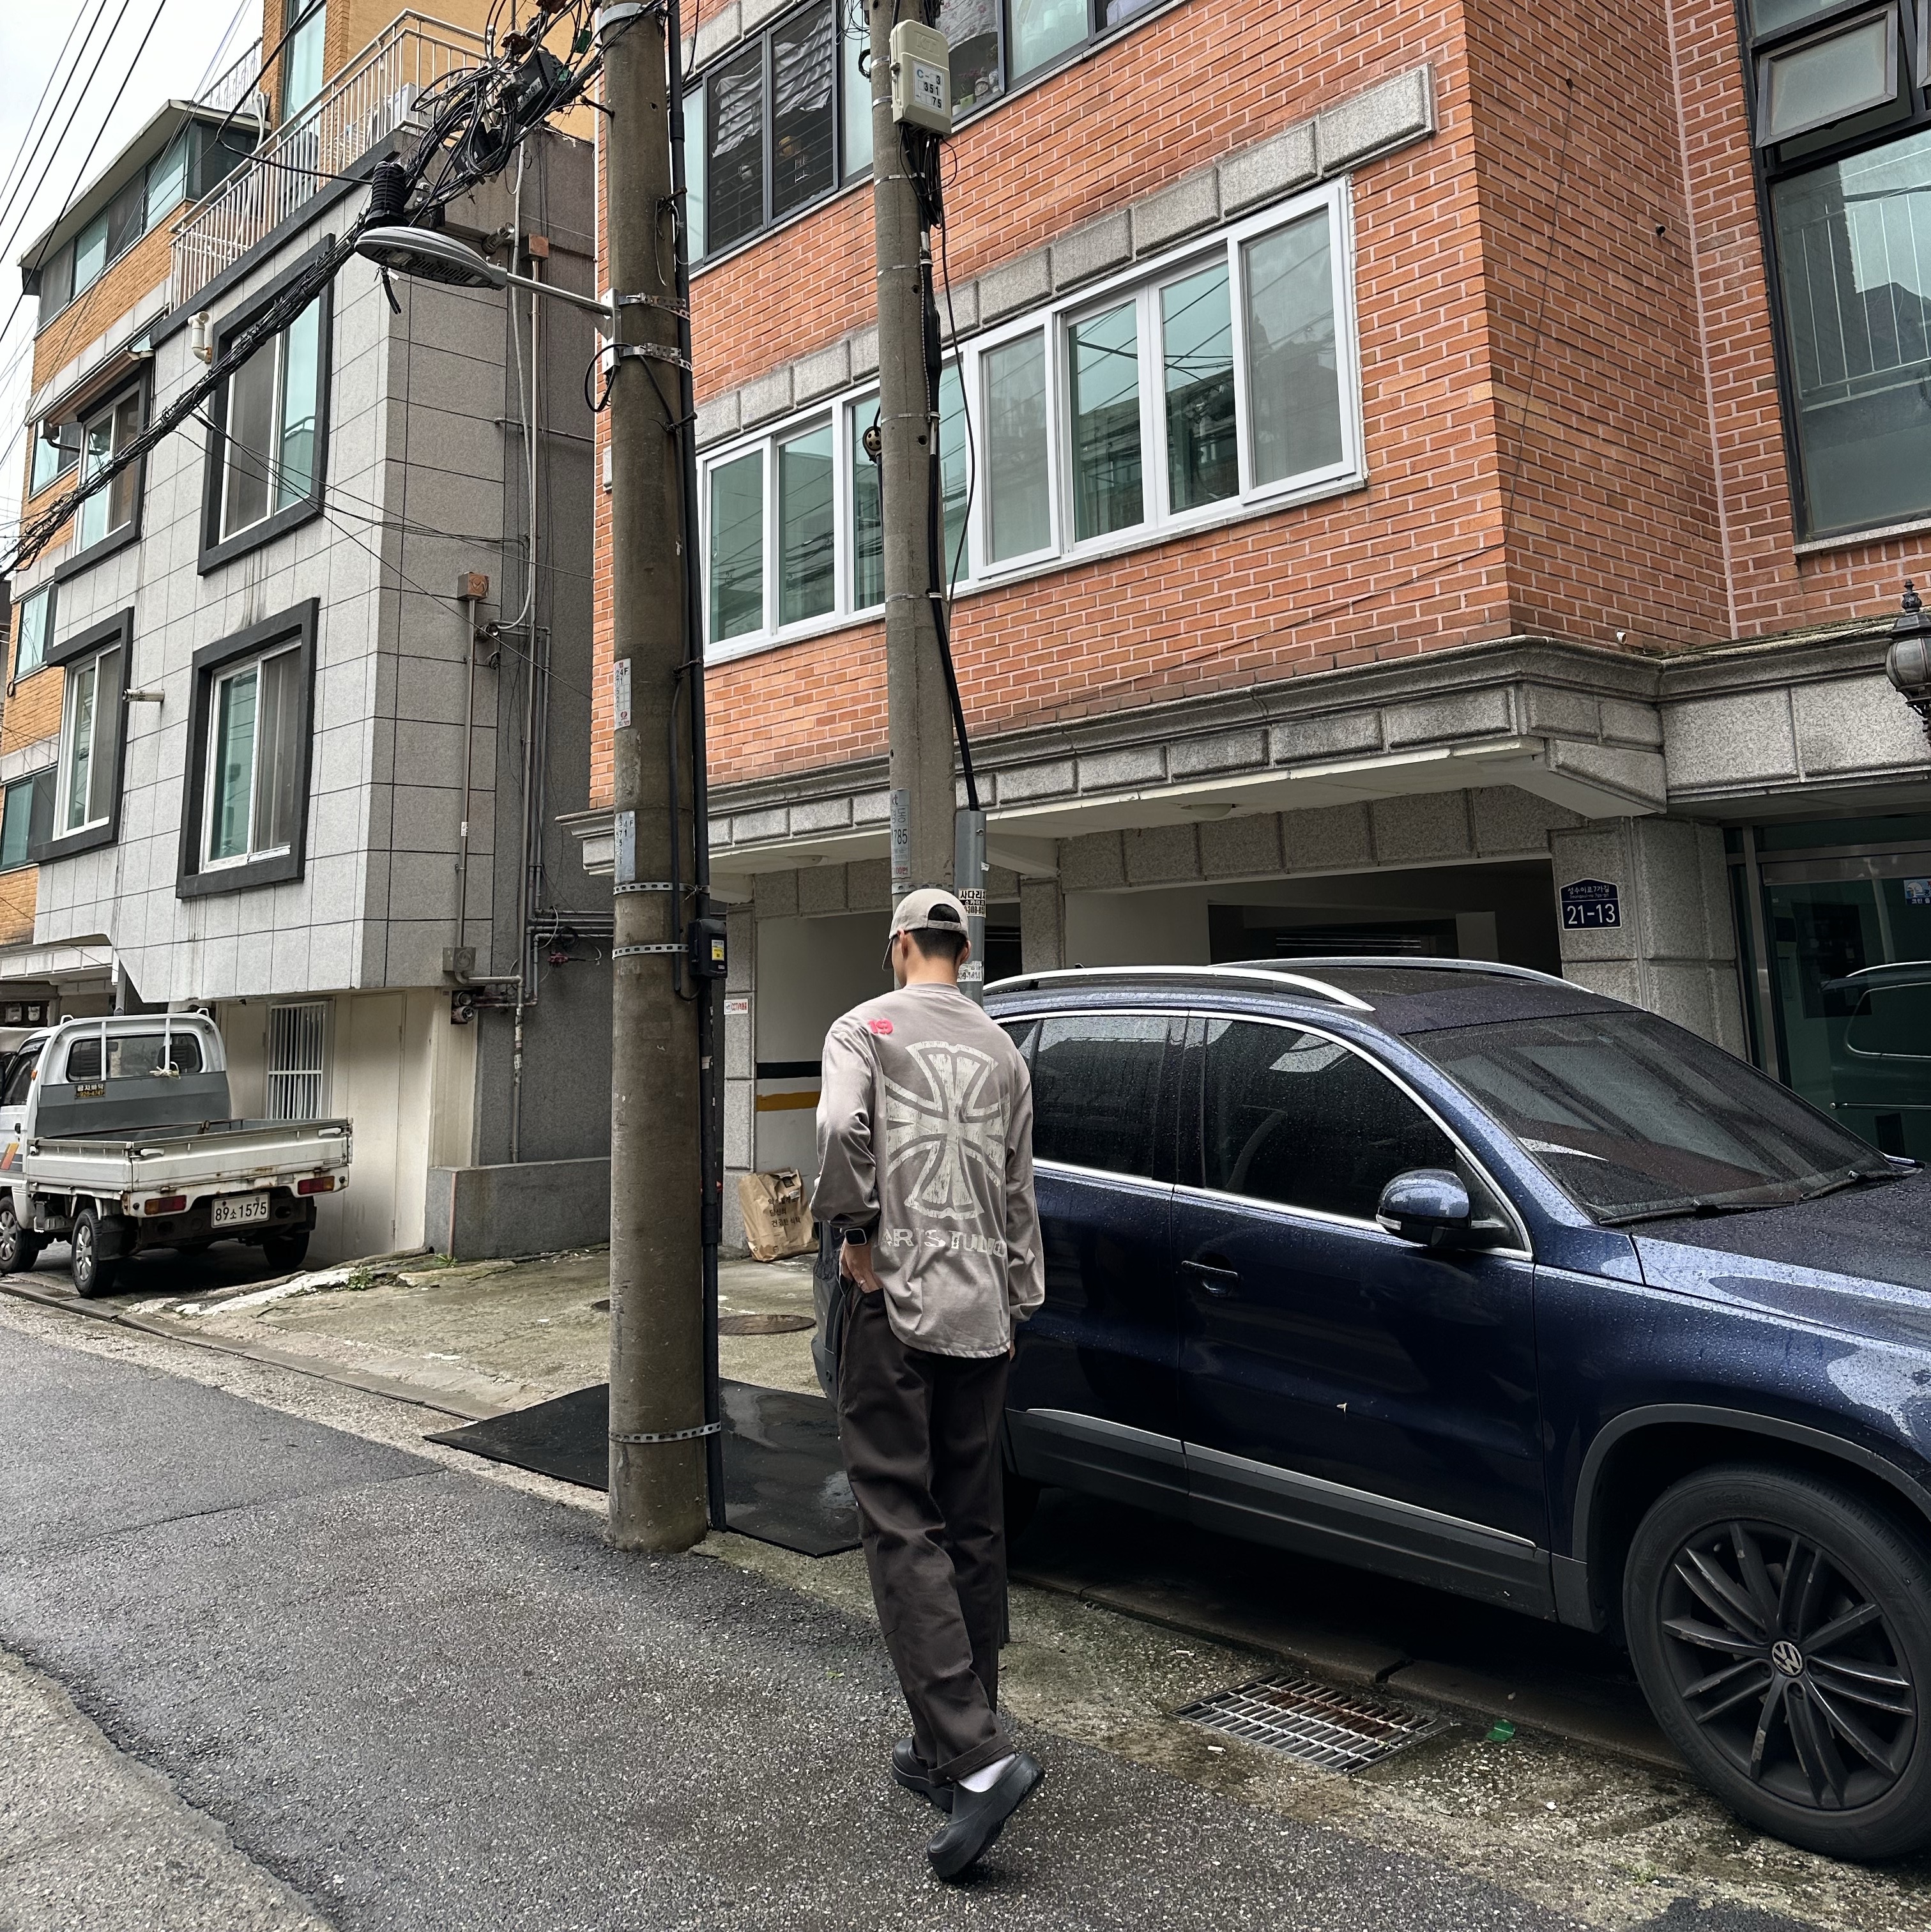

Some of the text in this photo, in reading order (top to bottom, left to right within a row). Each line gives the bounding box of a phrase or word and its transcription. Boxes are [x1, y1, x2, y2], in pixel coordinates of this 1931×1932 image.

[924, 82, 939, 96] 351
[1567, 903, 1616, 924] 21-13
[867, 1019, 894, 1035] 19
[215, 1202, 267, 1222] 89소1575
